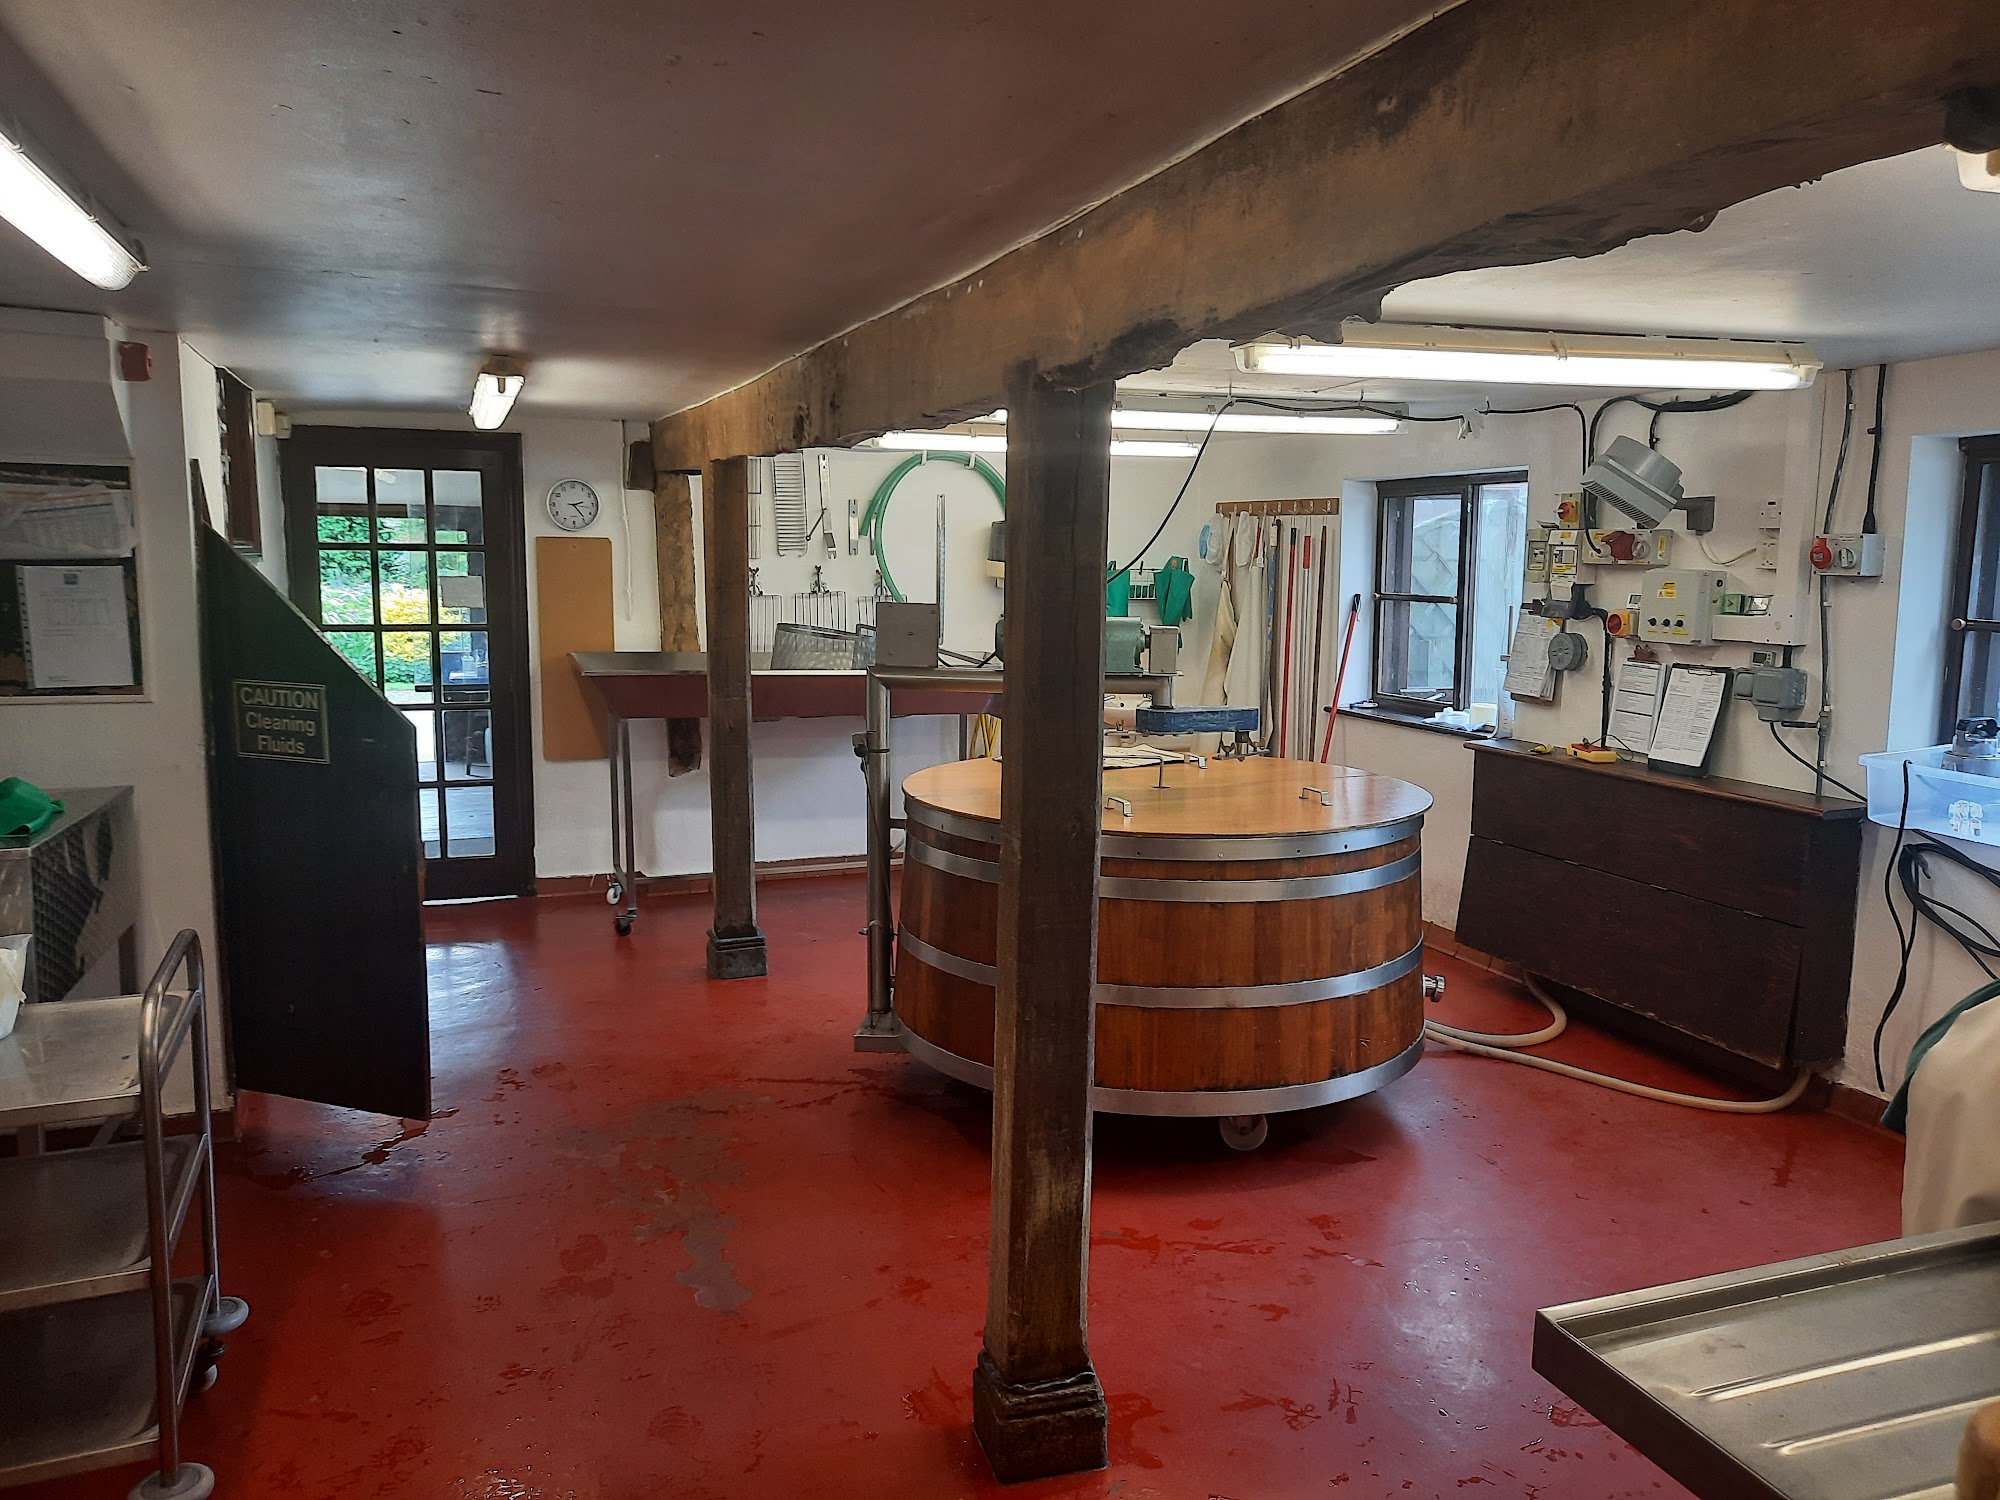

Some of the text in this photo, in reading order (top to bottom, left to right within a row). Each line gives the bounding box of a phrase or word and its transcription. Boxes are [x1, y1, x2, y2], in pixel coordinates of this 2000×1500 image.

[241, 687, 319, 709] CAUTION
[245, 711, 315, 737] Cleaning
[258, 734, 305, 755] Fluids
